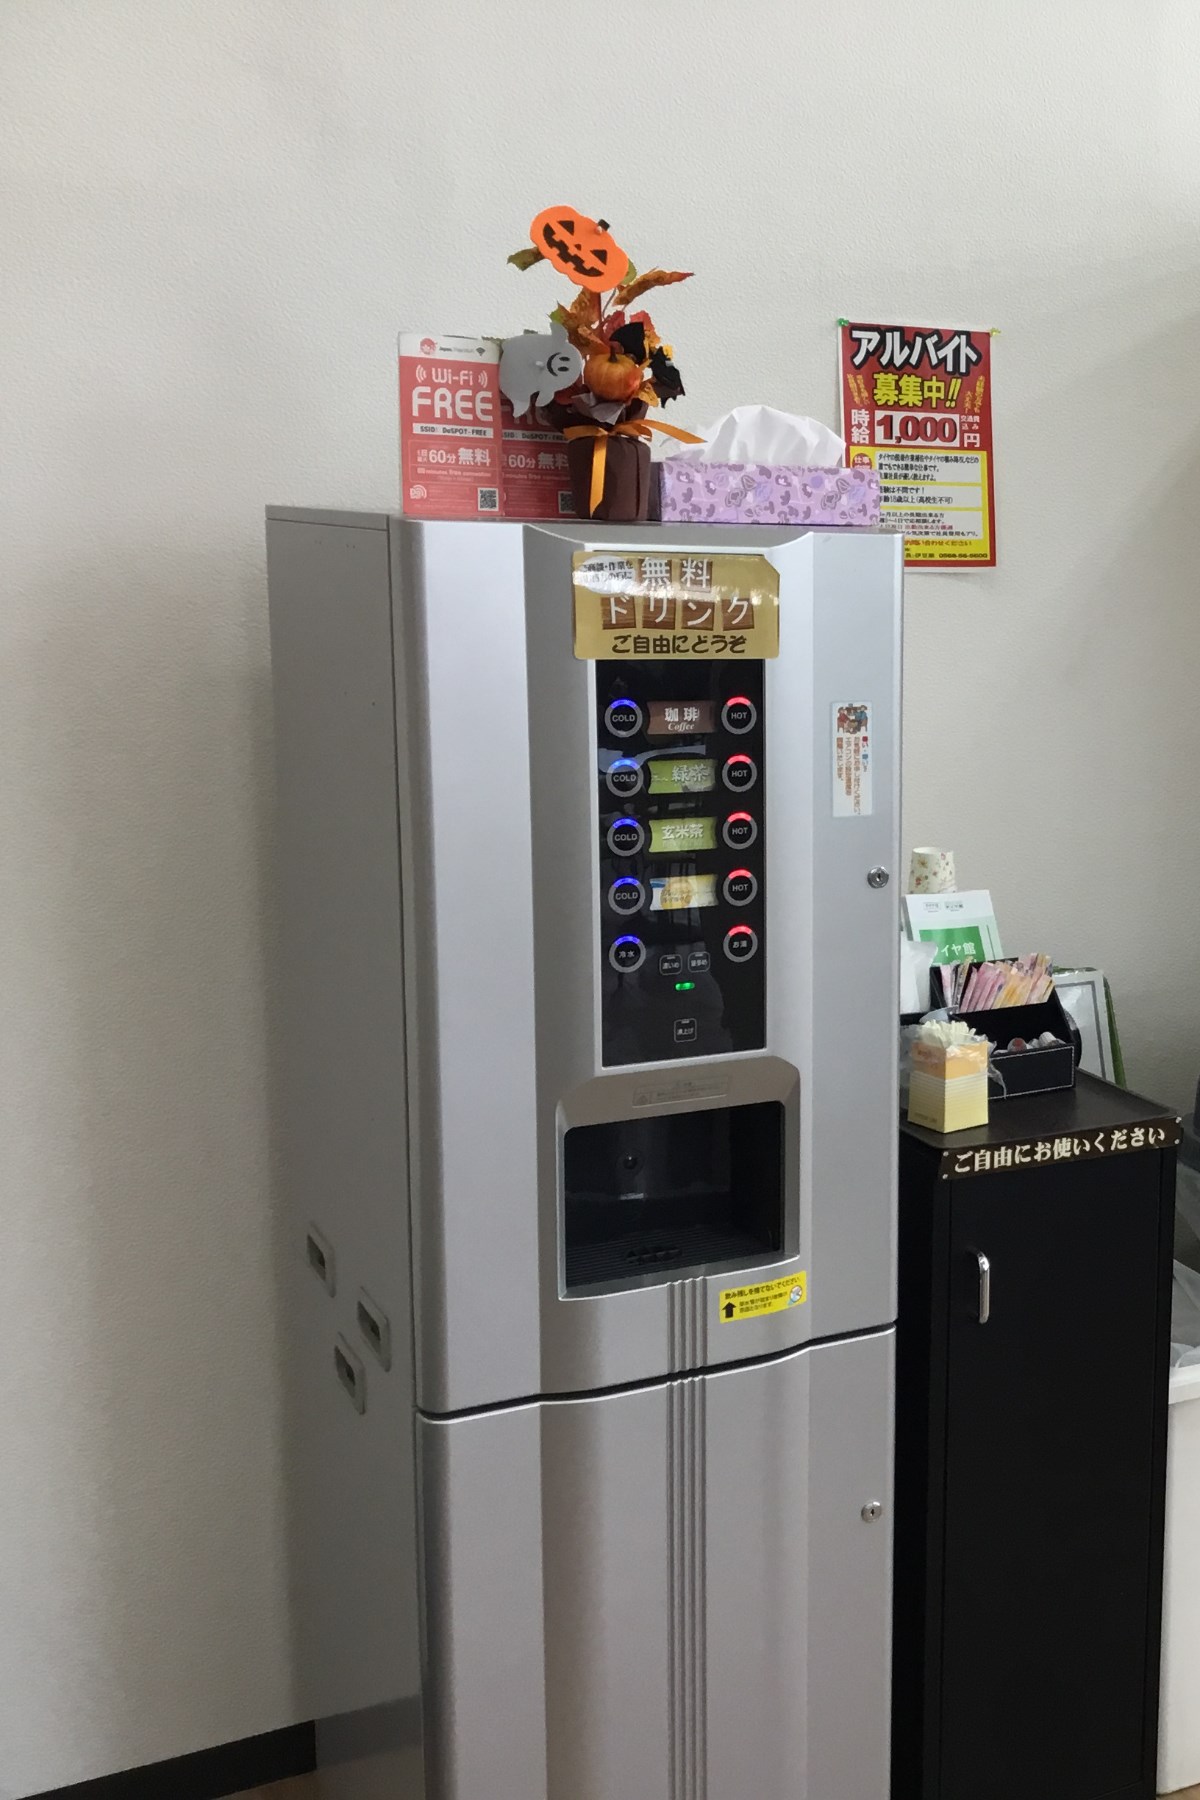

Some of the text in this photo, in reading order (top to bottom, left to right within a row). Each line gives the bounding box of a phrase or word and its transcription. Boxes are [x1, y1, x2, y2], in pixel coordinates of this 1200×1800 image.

[850, 328, 981, 374] アルバイト
[431, 367, 474, 387] Wi-Fi
[411, 385, 494, 422] FREE
[850, 408, 871, 445] 時給
[876, 413, 958, 445] 1,000
[963, 432, 981, 448] 円
[641, 556, 712, 591] 無料
[607, 594, 749, 627] ドリンク
[611, 633, 748, 655] ご自由にどうぞ
[611, 714, 636, 723] COLD
[664, 706, 700, 722] 珈琲
[730, 711, 748, 720] HOT
[667, 722, 695, 732] Coffee
[612, 774, 637, 783] COLD
[731, 770, 748, 778] HOT
[613, 833, 638, 842] COLD
[660, 823, 704, 840] 玄米茶
[731, 827, 748, 836] HOT
[731, 883, 749, 892] HOT
[614, 892, 639, 901] COLD
[618, 950, 636, 959] 冷水
[954, 1127, 1165, 1174] ご自由にお使いください
